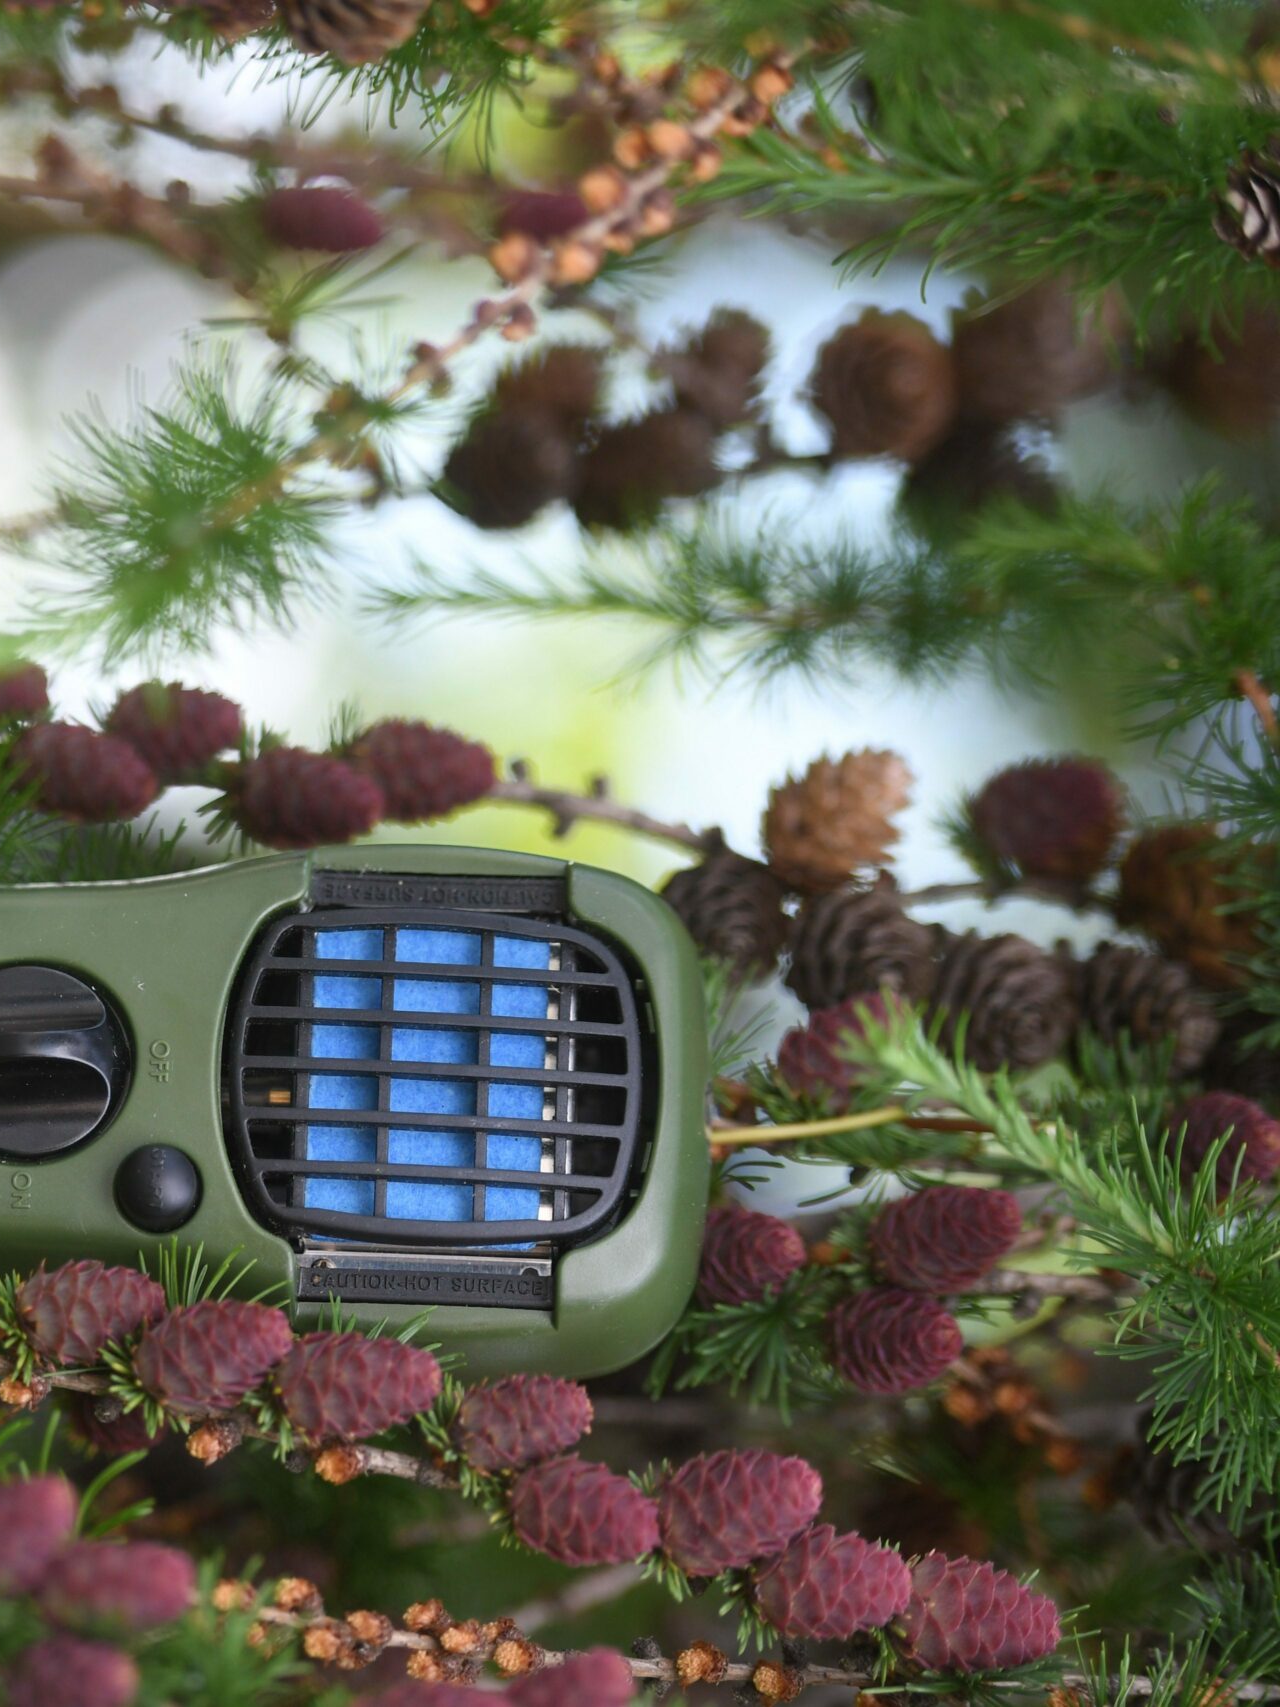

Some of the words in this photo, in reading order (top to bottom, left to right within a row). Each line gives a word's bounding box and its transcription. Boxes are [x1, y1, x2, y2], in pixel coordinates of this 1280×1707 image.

[150, 1039, 171, 1083] OFF
[11, 1171, 32, 1210] ON
[450, 1276, 546, 1297] SURFACE
